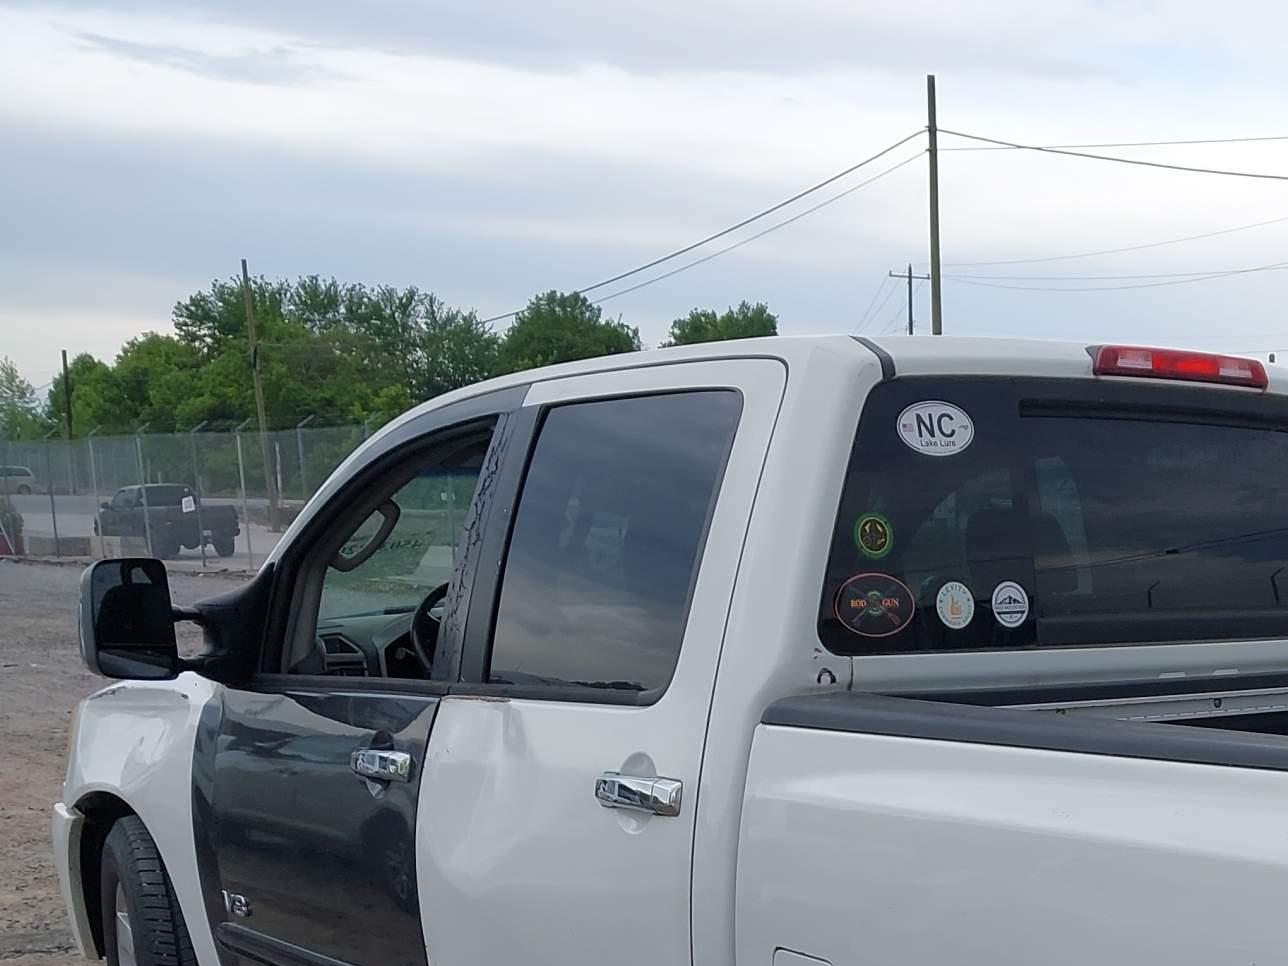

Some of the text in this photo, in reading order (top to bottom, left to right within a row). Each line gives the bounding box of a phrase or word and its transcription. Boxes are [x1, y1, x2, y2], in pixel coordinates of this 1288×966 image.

[915, 412, 956, 438] NC
[920, 439, 938, 447] Lake
[881, 598, 899, 608] GUN
[221, 890, 248, 917] V8
